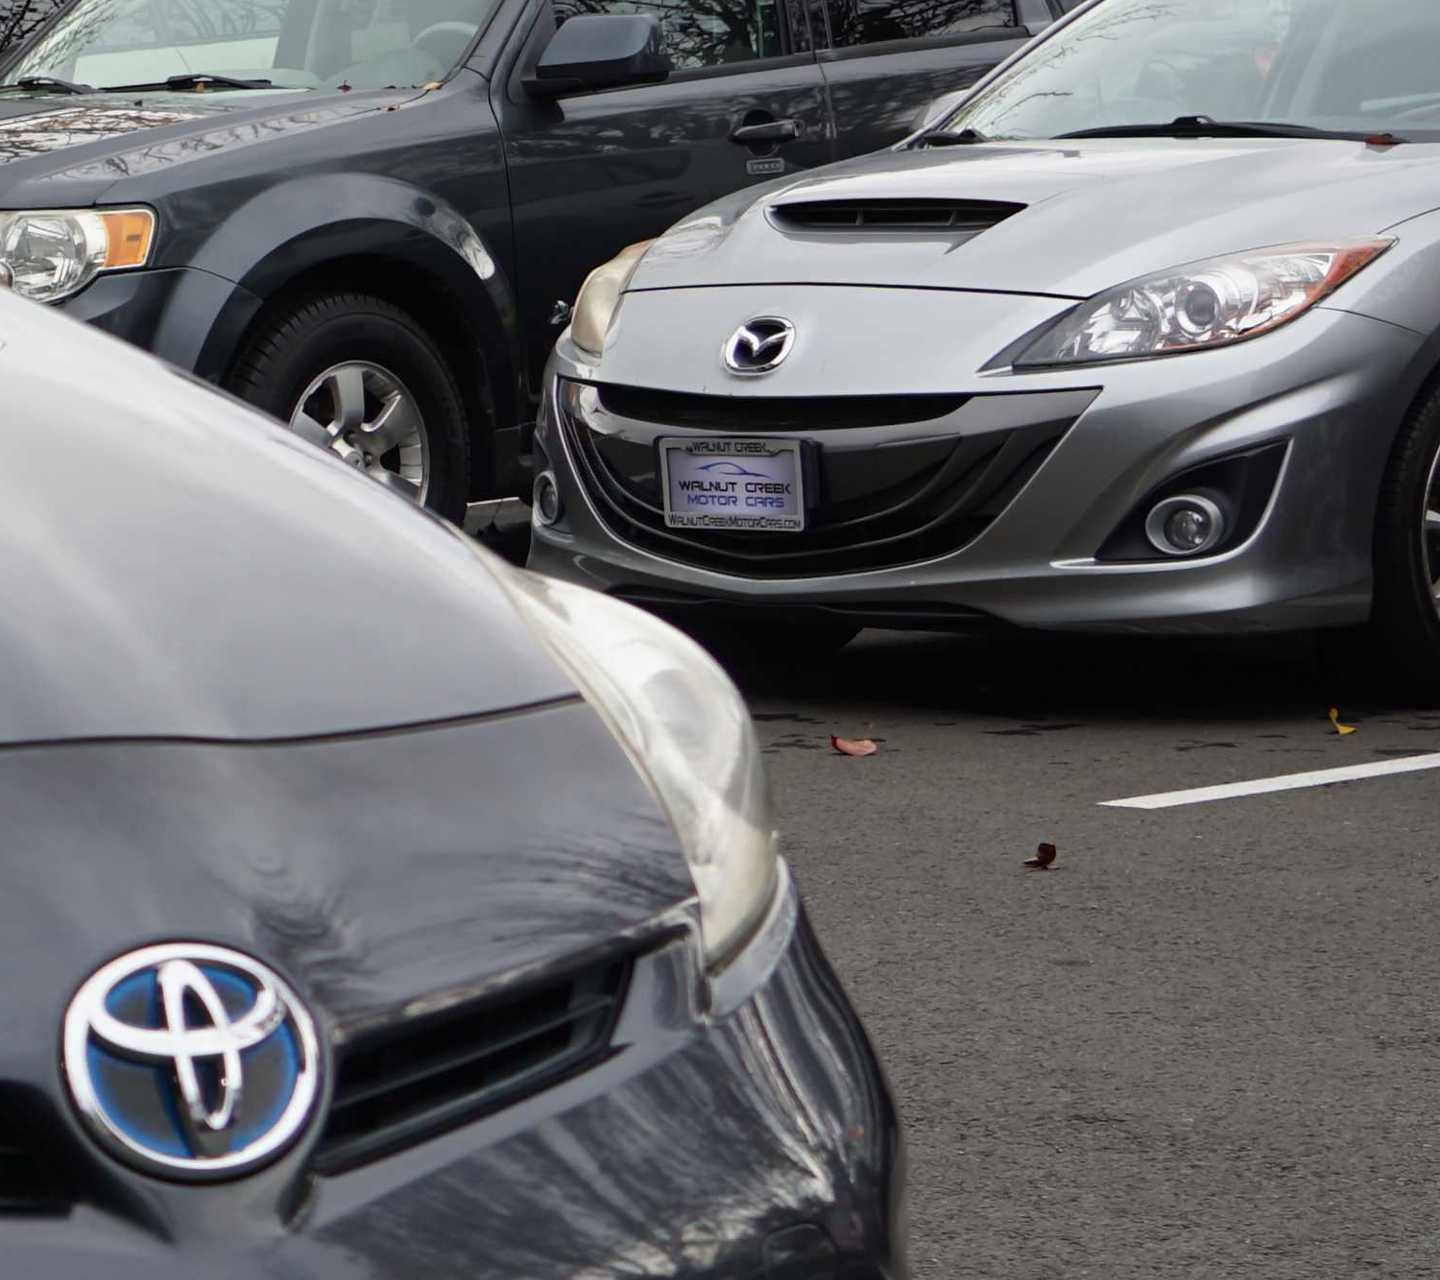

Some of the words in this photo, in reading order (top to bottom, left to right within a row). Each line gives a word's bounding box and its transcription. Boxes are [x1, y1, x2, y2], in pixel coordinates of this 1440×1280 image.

[692, 441, 731, 453] WALNUT
[734, 441, 766, 453] CREEK
[678, 481, 737, 492] WALNUT
[745, 482, 791, 494] CREEK
[687, 494, 737, 506] MOTOR
[745, 496, 785, 508] CARS
